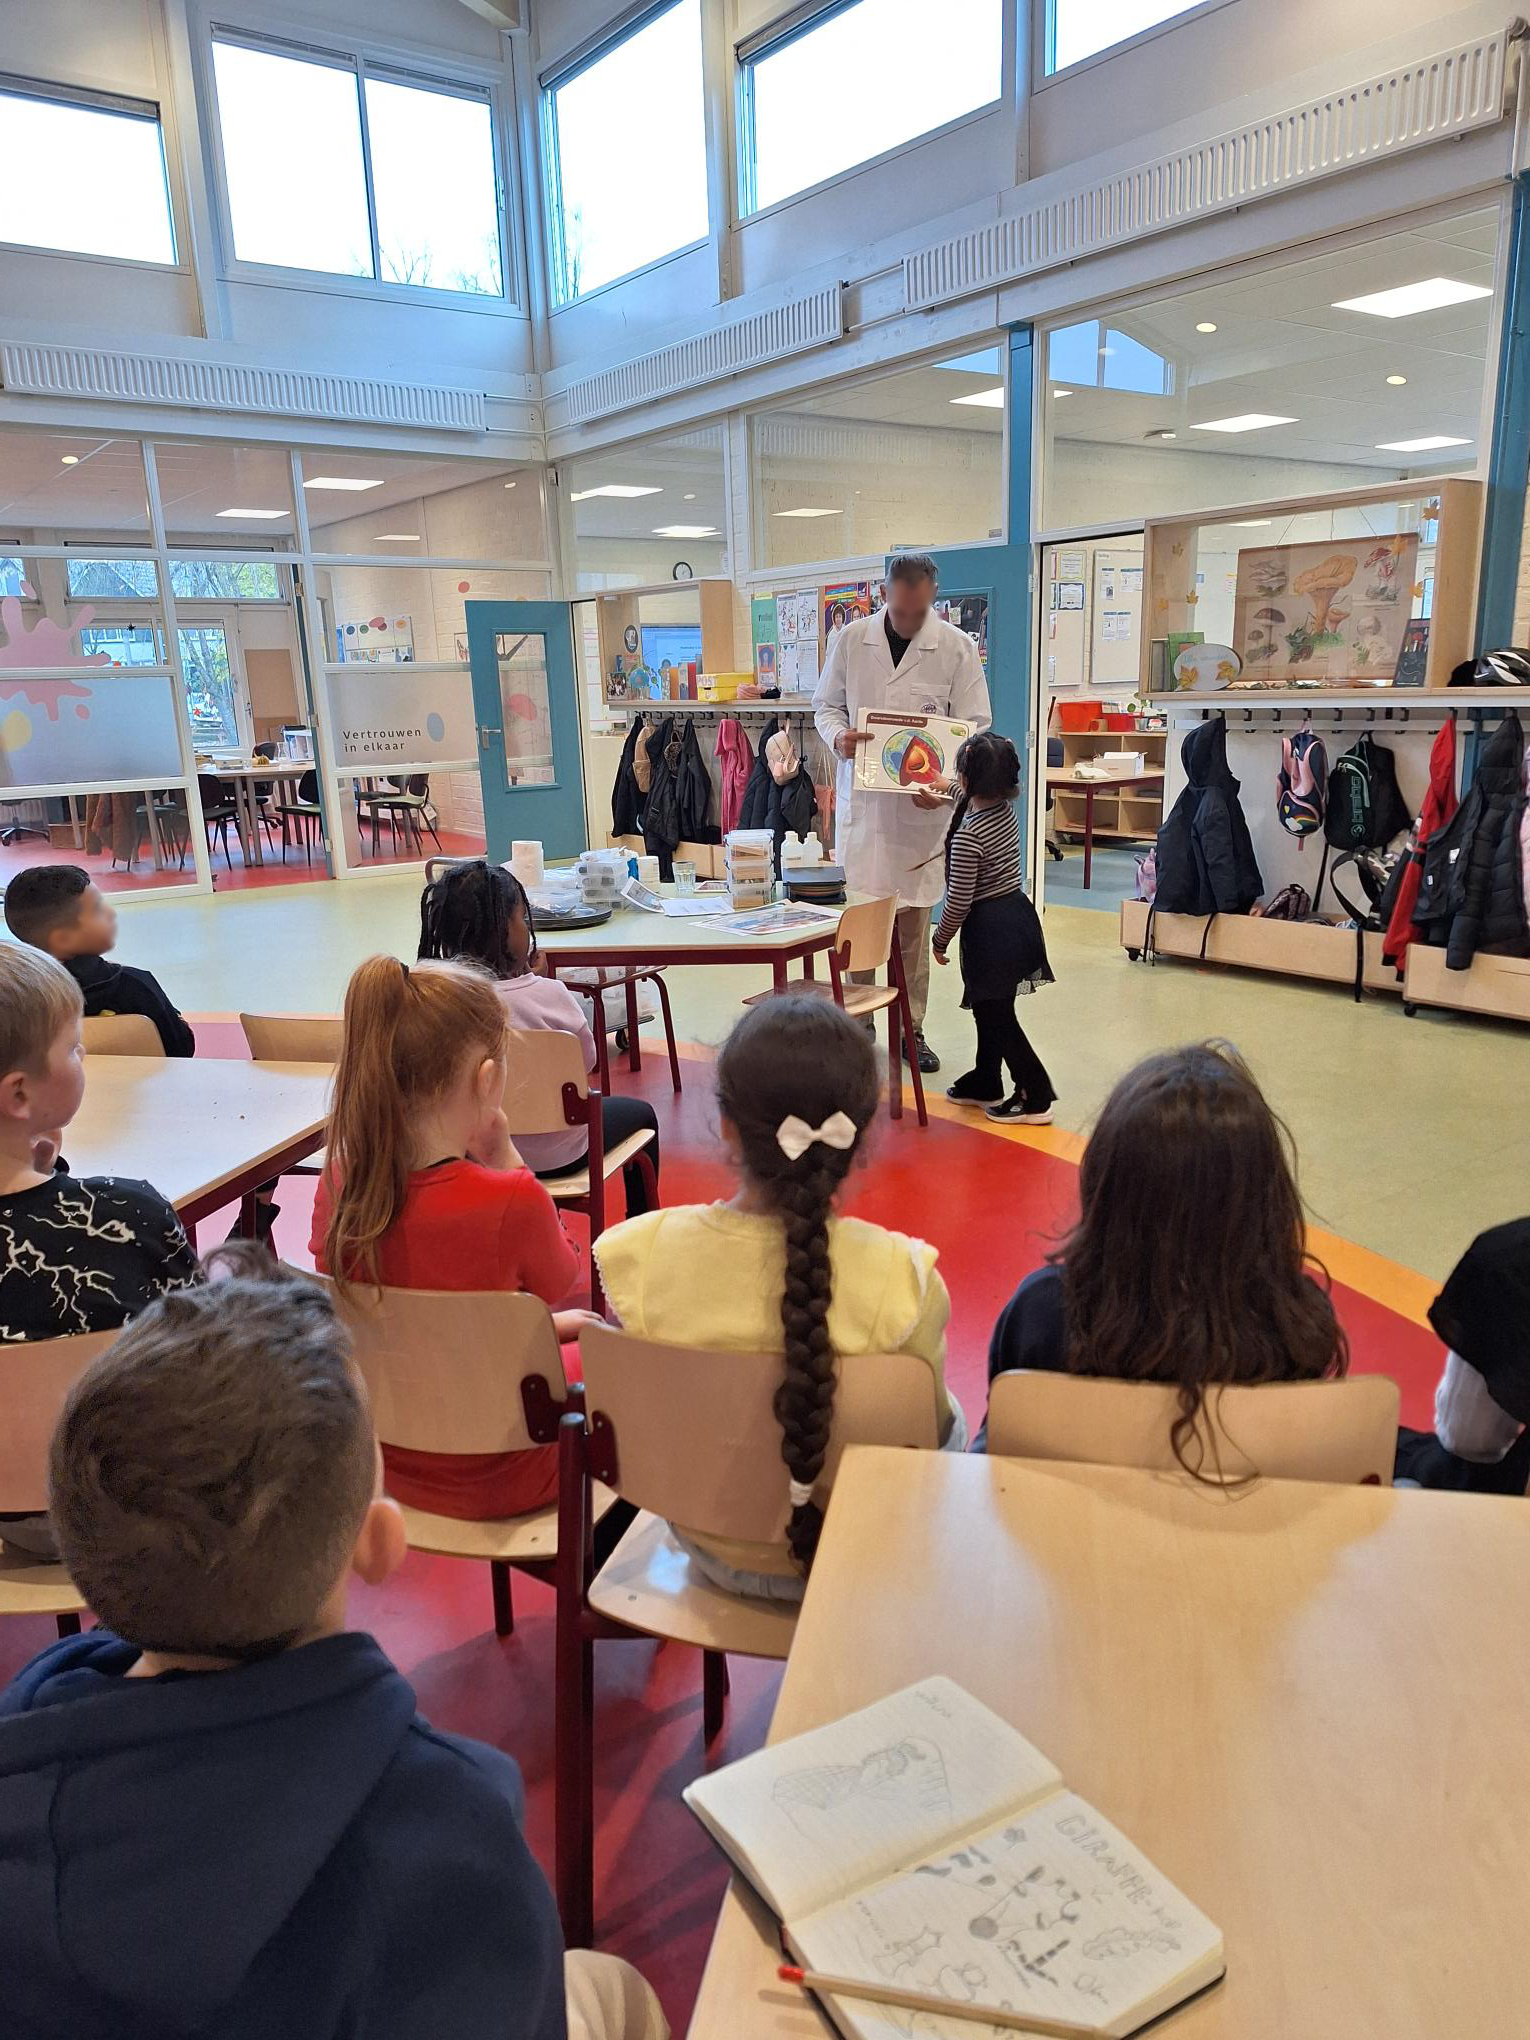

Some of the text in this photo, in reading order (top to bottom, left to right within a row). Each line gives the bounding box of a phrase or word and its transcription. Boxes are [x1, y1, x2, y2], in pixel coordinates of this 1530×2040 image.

[342, 729, 421, 740] Vertrouwen
[344, 742, 405, 752] in elkaar
